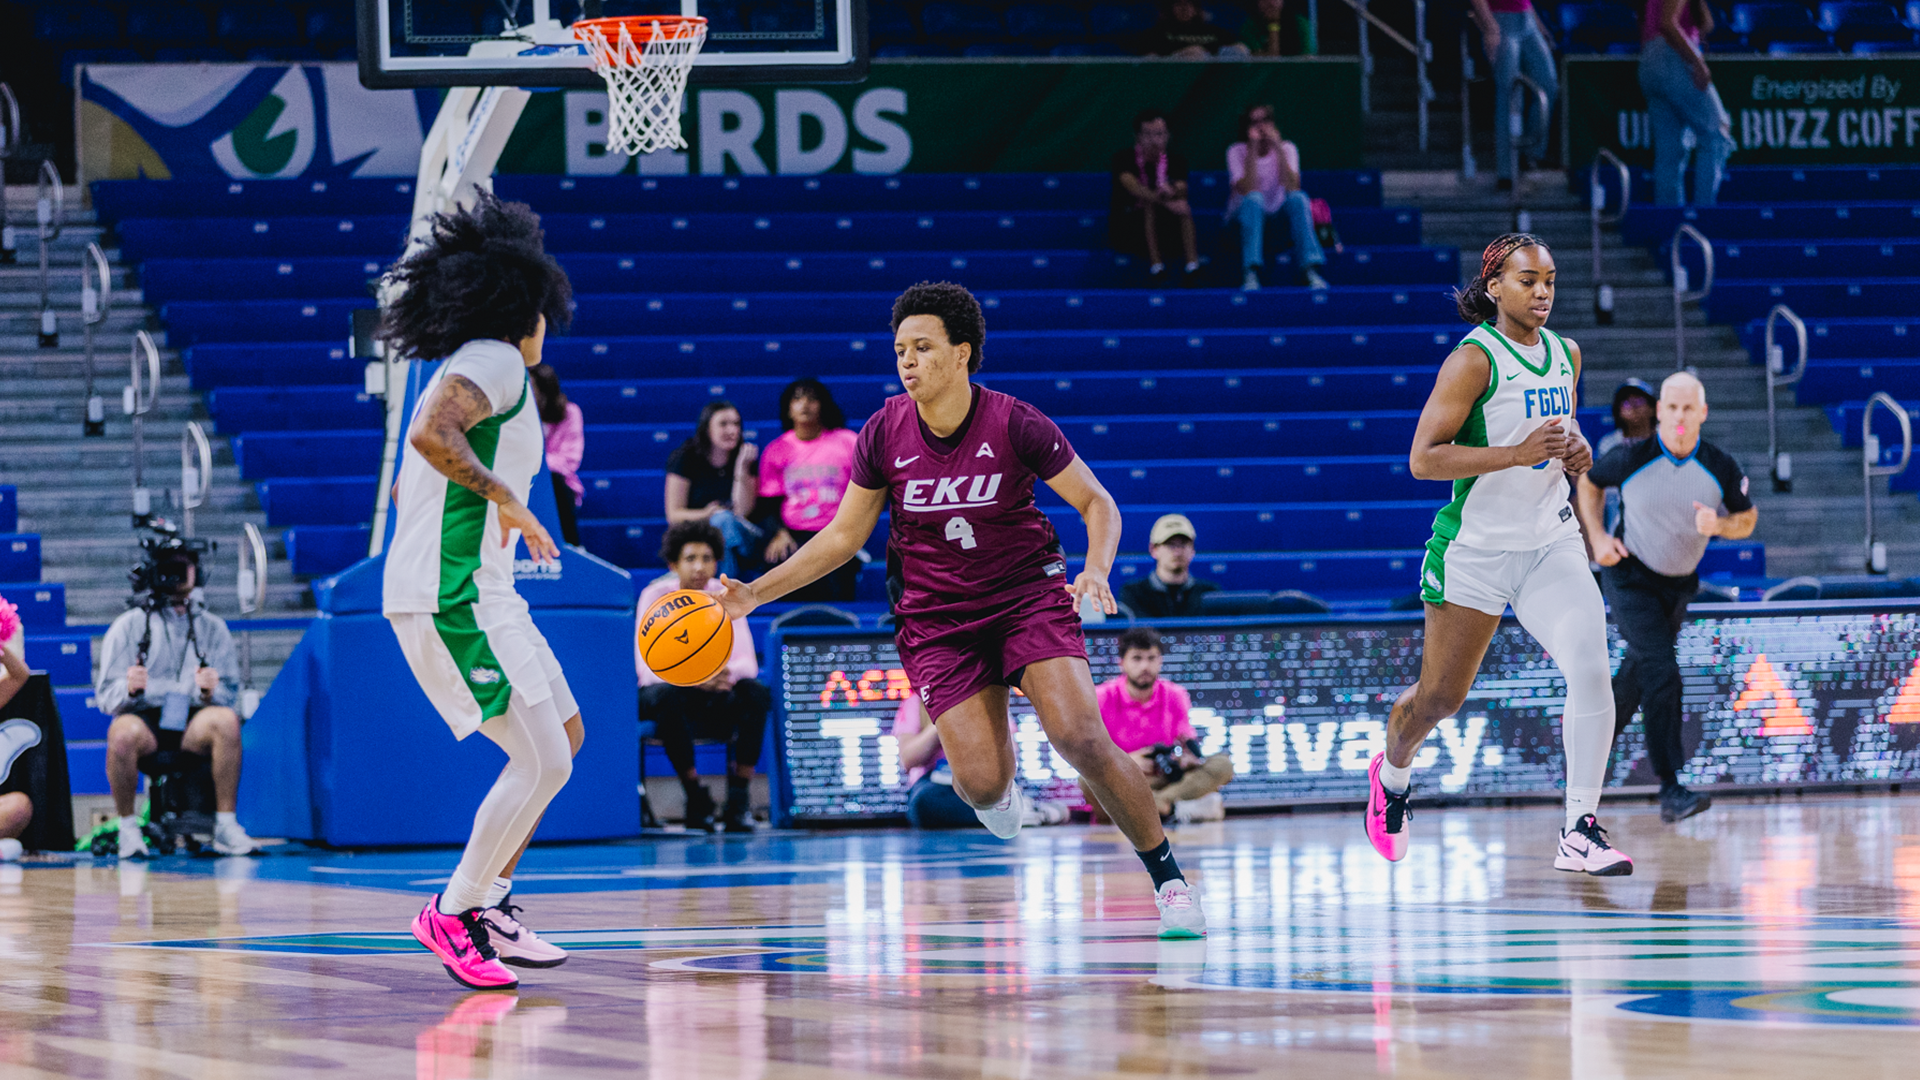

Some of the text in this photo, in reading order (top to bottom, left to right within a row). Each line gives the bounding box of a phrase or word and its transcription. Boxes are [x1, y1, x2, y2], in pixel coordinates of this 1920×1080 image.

[1752, 75, 1901, 104] Energized By
[1741, 108, 1829, 149] BUZZ
[1523, 386, 1570, 419] FGCU
[903, 473, 1003, 505] EKU
[944, 516, 977, 550] 4
[641, 595, 696, 637] Wilson
